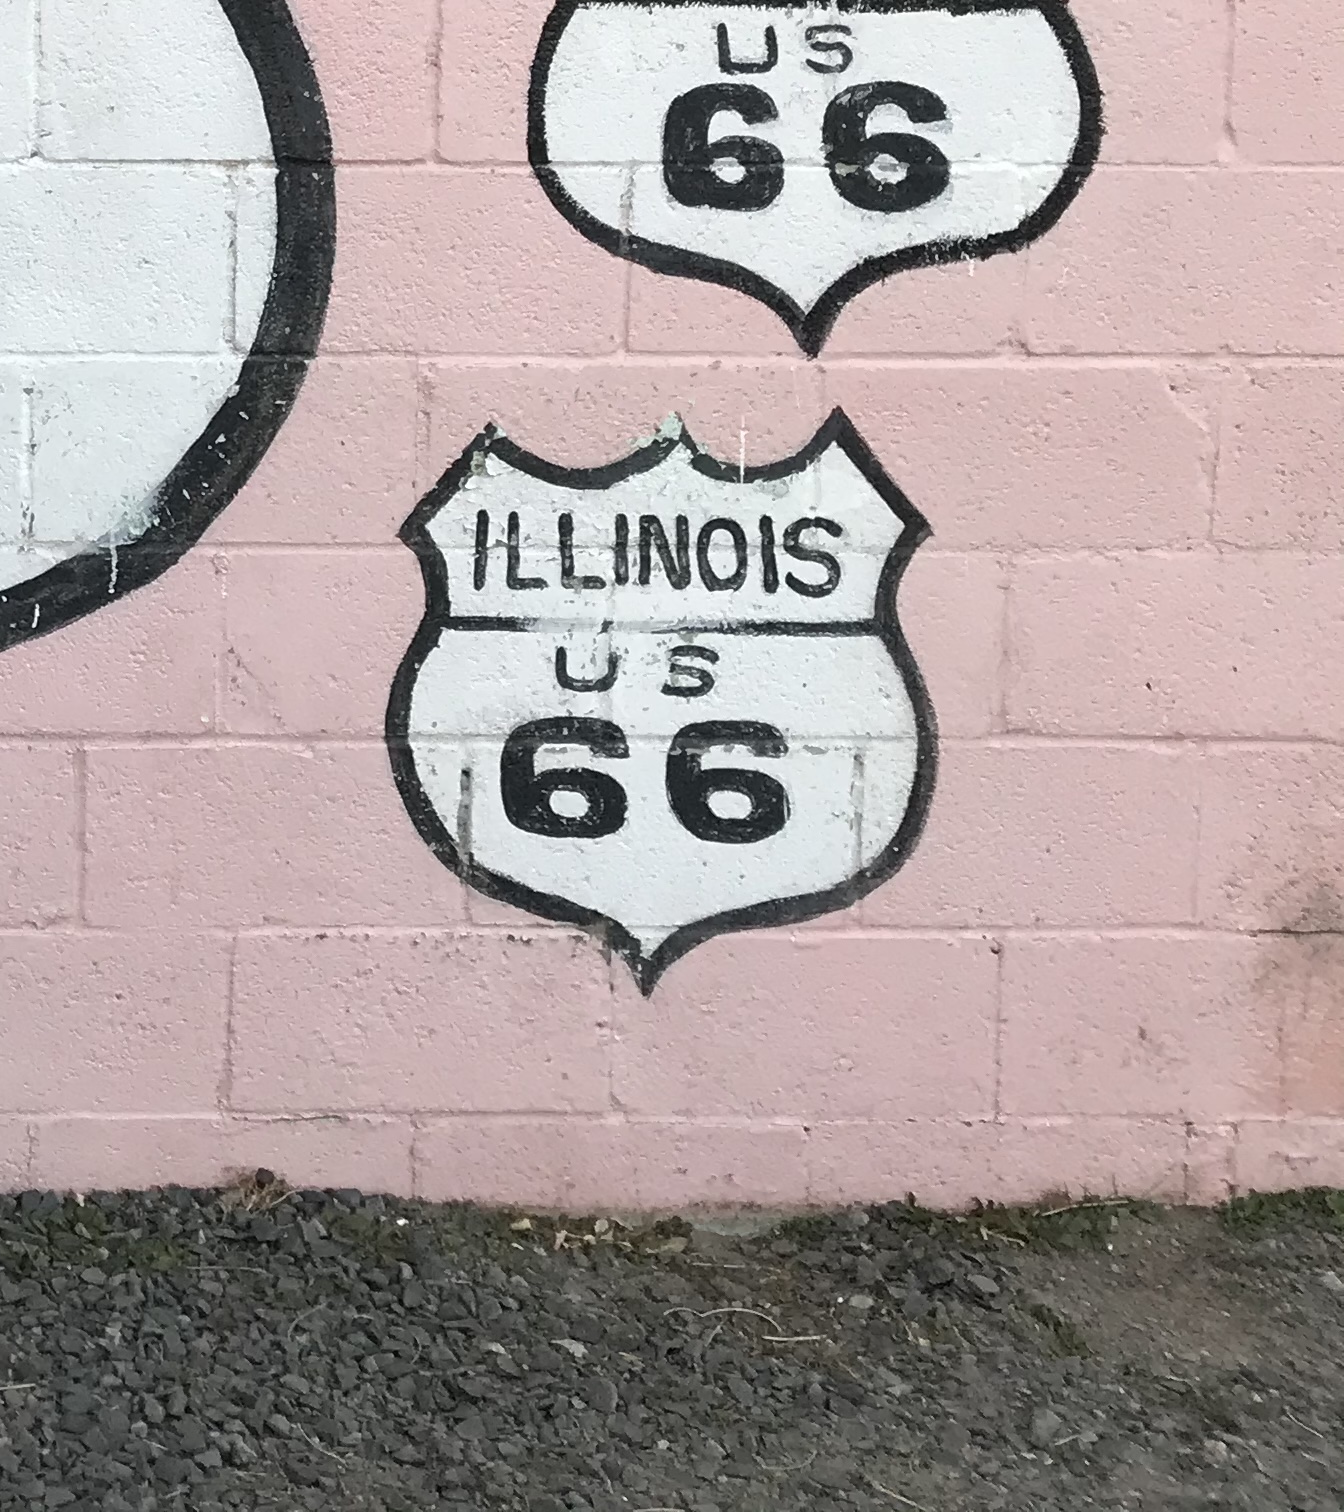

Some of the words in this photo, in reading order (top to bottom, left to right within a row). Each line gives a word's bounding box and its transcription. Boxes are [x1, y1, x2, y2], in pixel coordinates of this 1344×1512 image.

[662, 81, 952, 213] 66
[473, 509, 843, 599] ILLINOIS
[500, 715, 791, 844] 66
